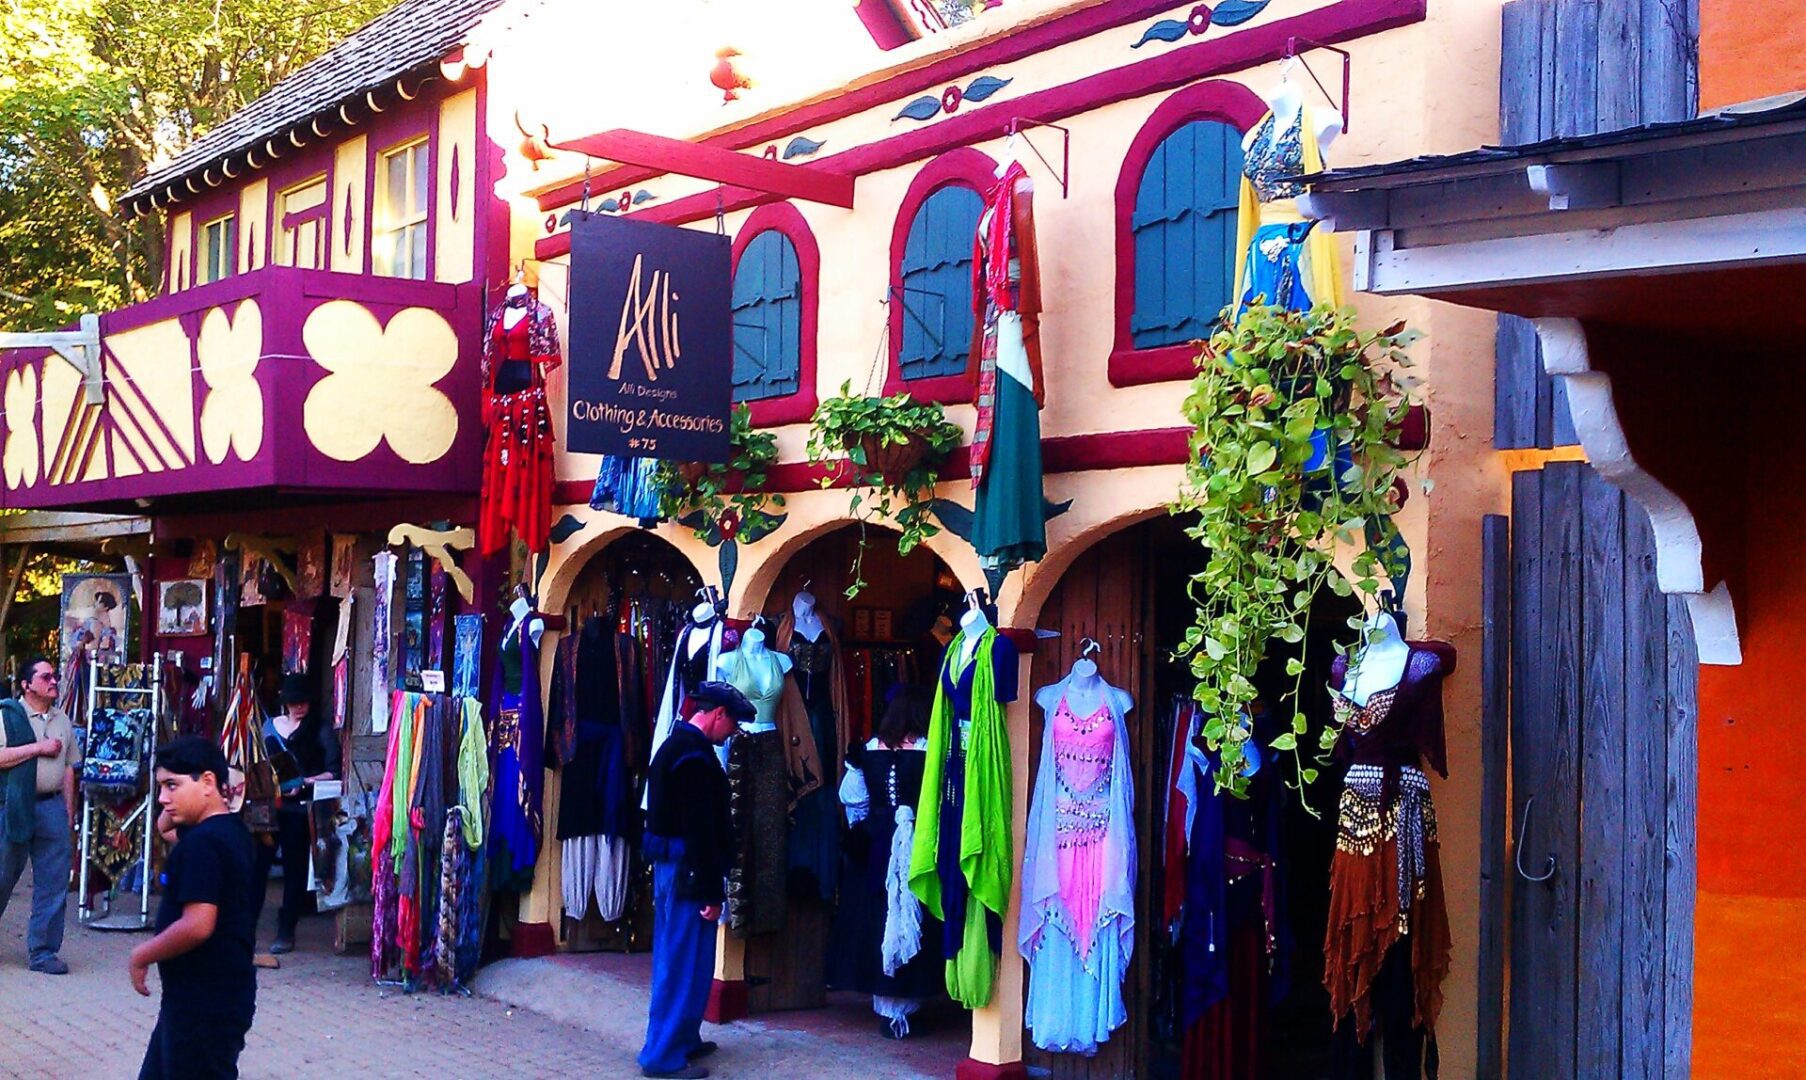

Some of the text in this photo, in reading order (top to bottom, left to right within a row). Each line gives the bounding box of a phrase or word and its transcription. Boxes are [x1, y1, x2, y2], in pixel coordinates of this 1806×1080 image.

[607, 253, 680, 381] Alli
[618, 382, 678, 402] Alli Designs
[573, 400, 723, 433] Clothing & Accessories
[628, 438, 656, 450] #75
